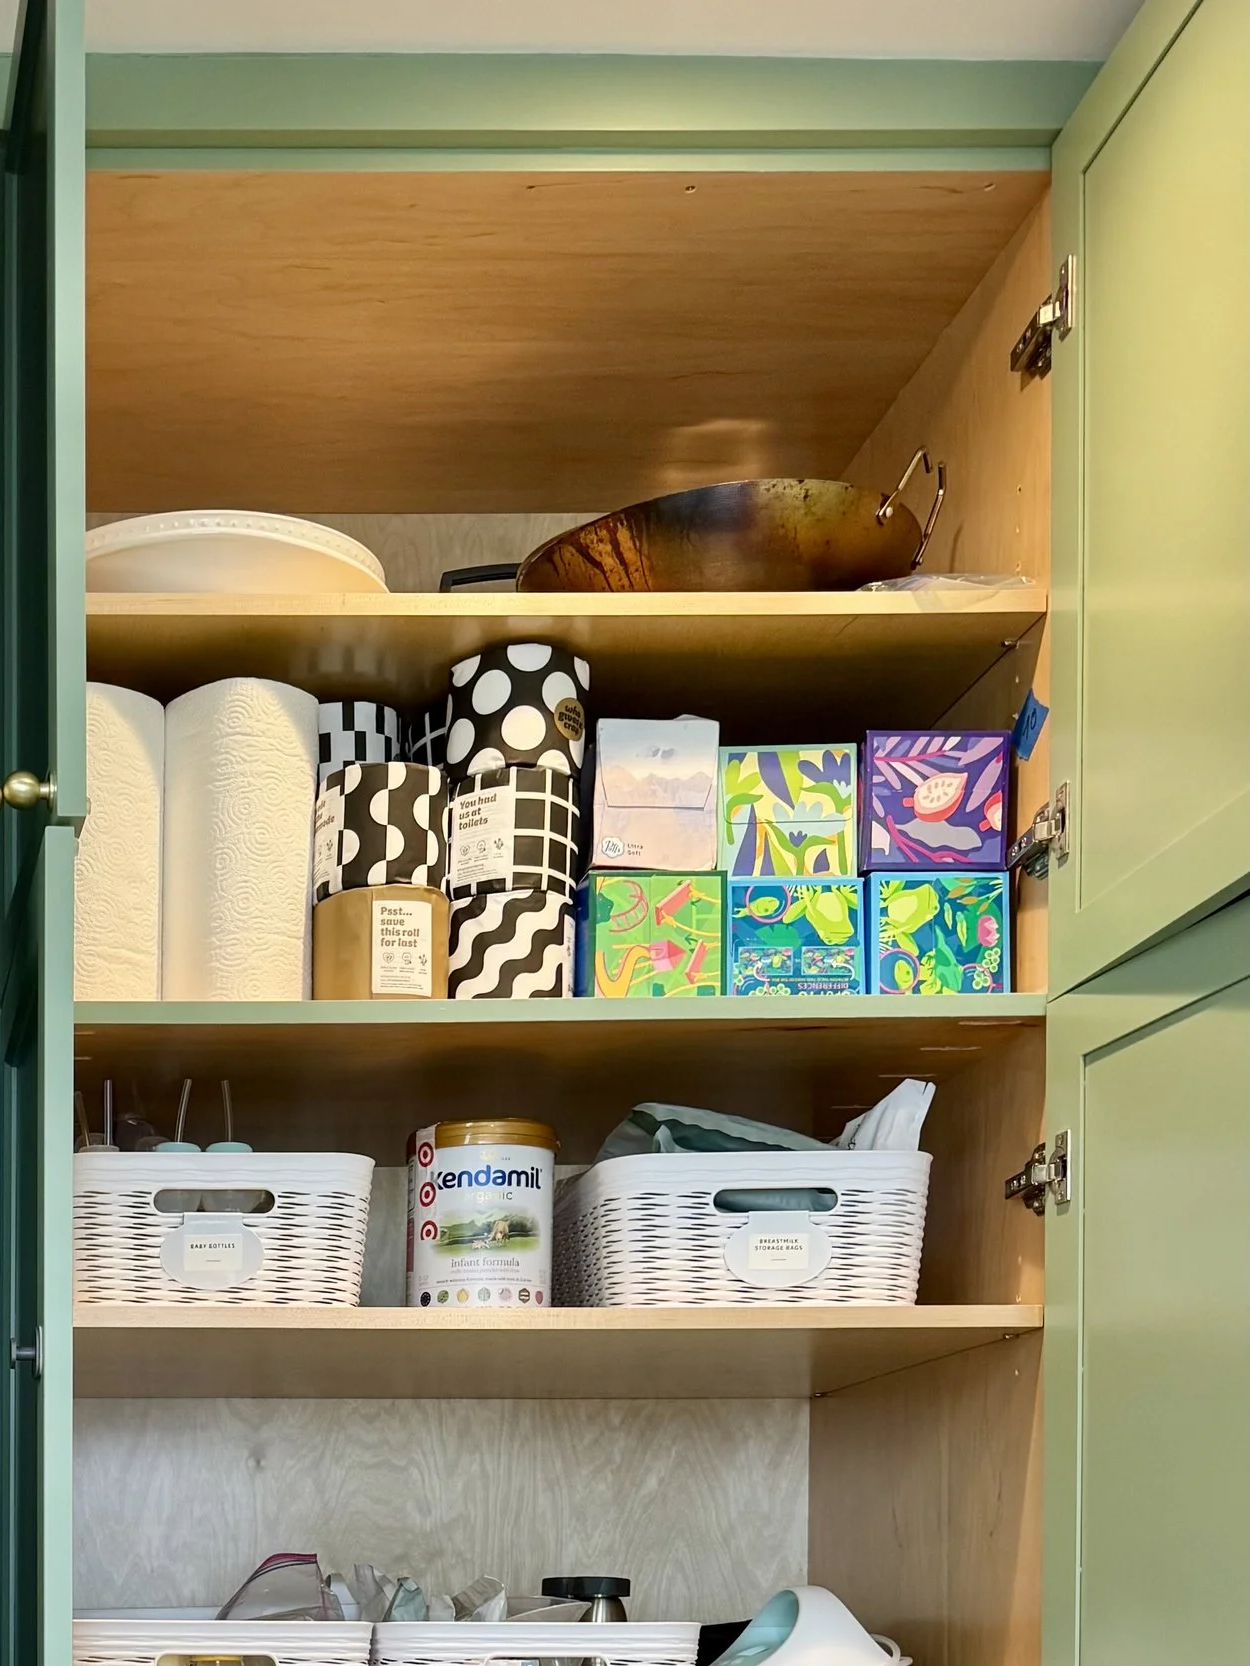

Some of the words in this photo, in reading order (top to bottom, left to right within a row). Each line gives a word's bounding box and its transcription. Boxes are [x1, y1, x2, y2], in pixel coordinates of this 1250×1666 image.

[564, 704, 581, 719] who
[460, 797, 477, 810] You
[478, 794, 497, 805] had
[459, 812, 470, 820] us
[472, 808, 482, 818] at
[458, 817, 488, 830] toilets
[380, 906, 412, 916] Psst...
[380, 926, 401, 936] this
[402, 928, 420, 936] roll
[380, 938, 396, 948] for
[398, 938, 417, 948] last
[450, 1258, 481, 1268] infant
[482, 1257, 520, 1268] formula
